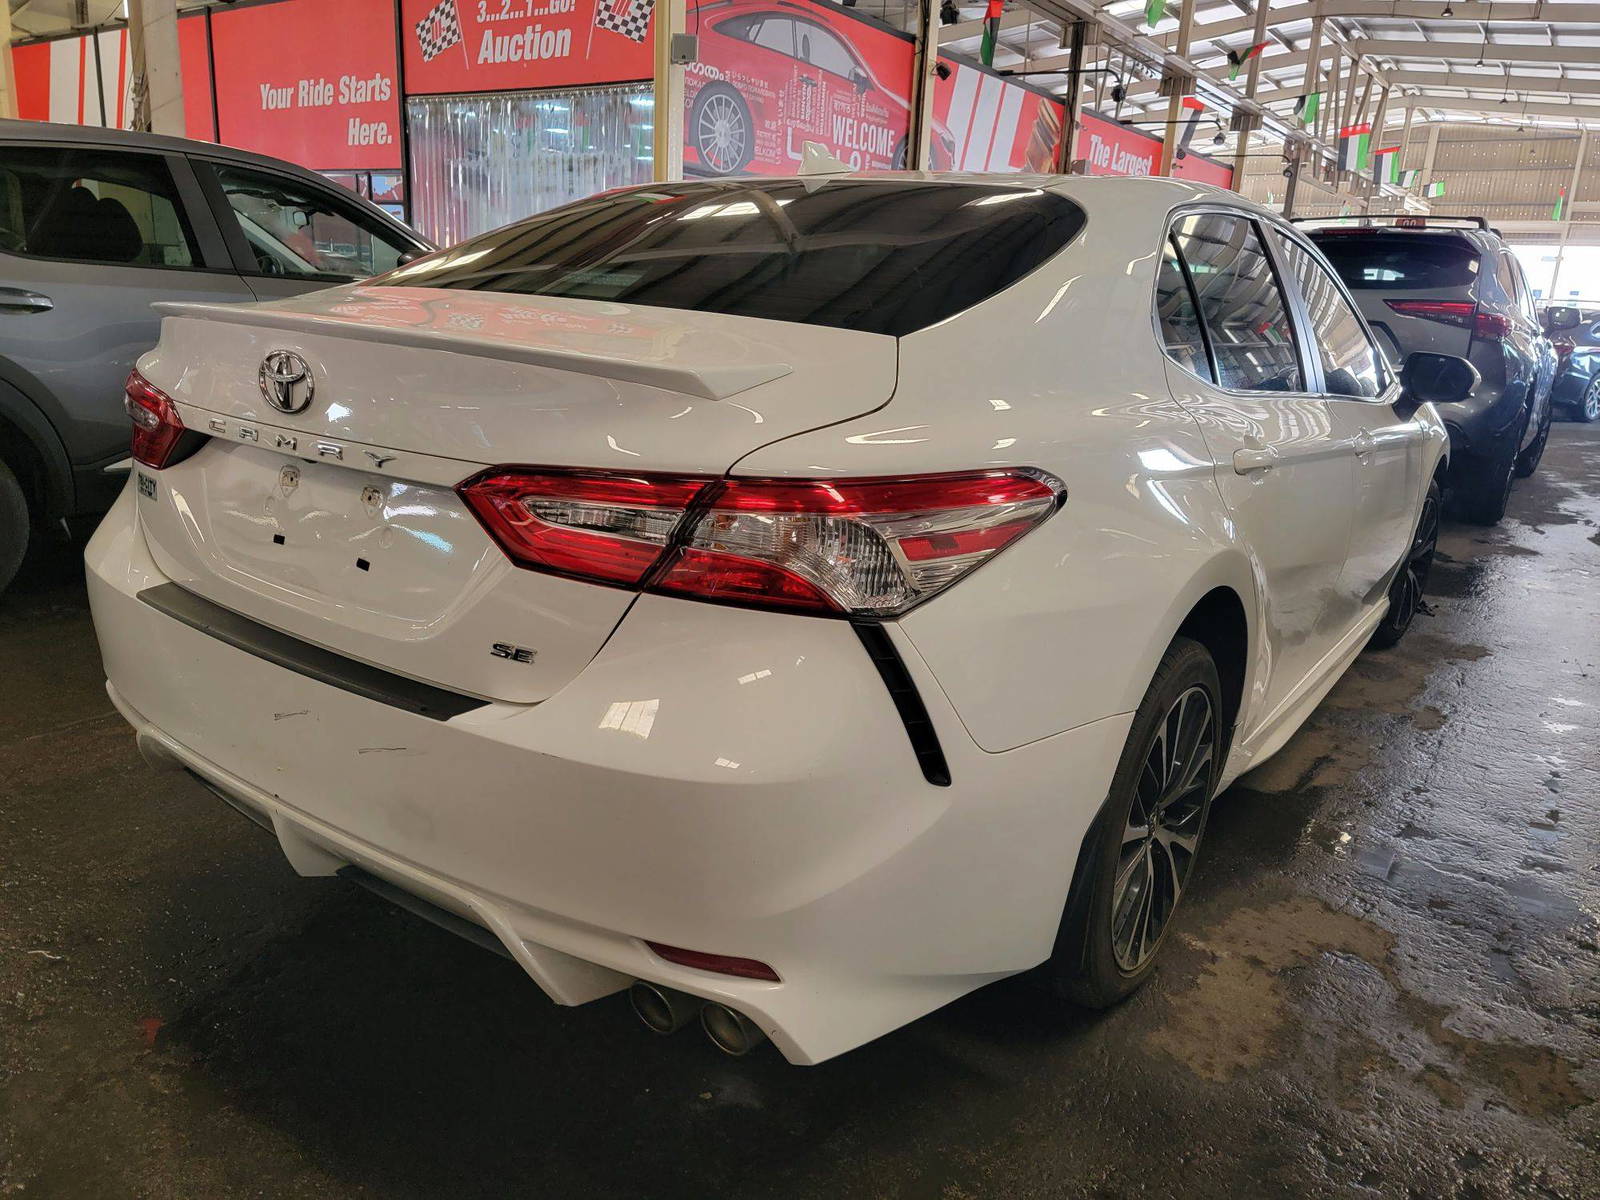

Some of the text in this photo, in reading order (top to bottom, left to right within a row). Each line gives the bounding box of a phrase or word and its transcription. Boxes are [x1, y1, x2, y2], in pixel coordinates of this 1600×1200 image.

[478, 24, 572, 64] Auction
[260, 73, 391, 111] Your Ride Starts
[347, 118, 392, 146] Here.
[832, 113, 896, 158] WELCOME
[1089, 134, 1153, 176] The Largest
[208, 416, 397, 469] CAMRY
[490, 642, 537, 664] SE
